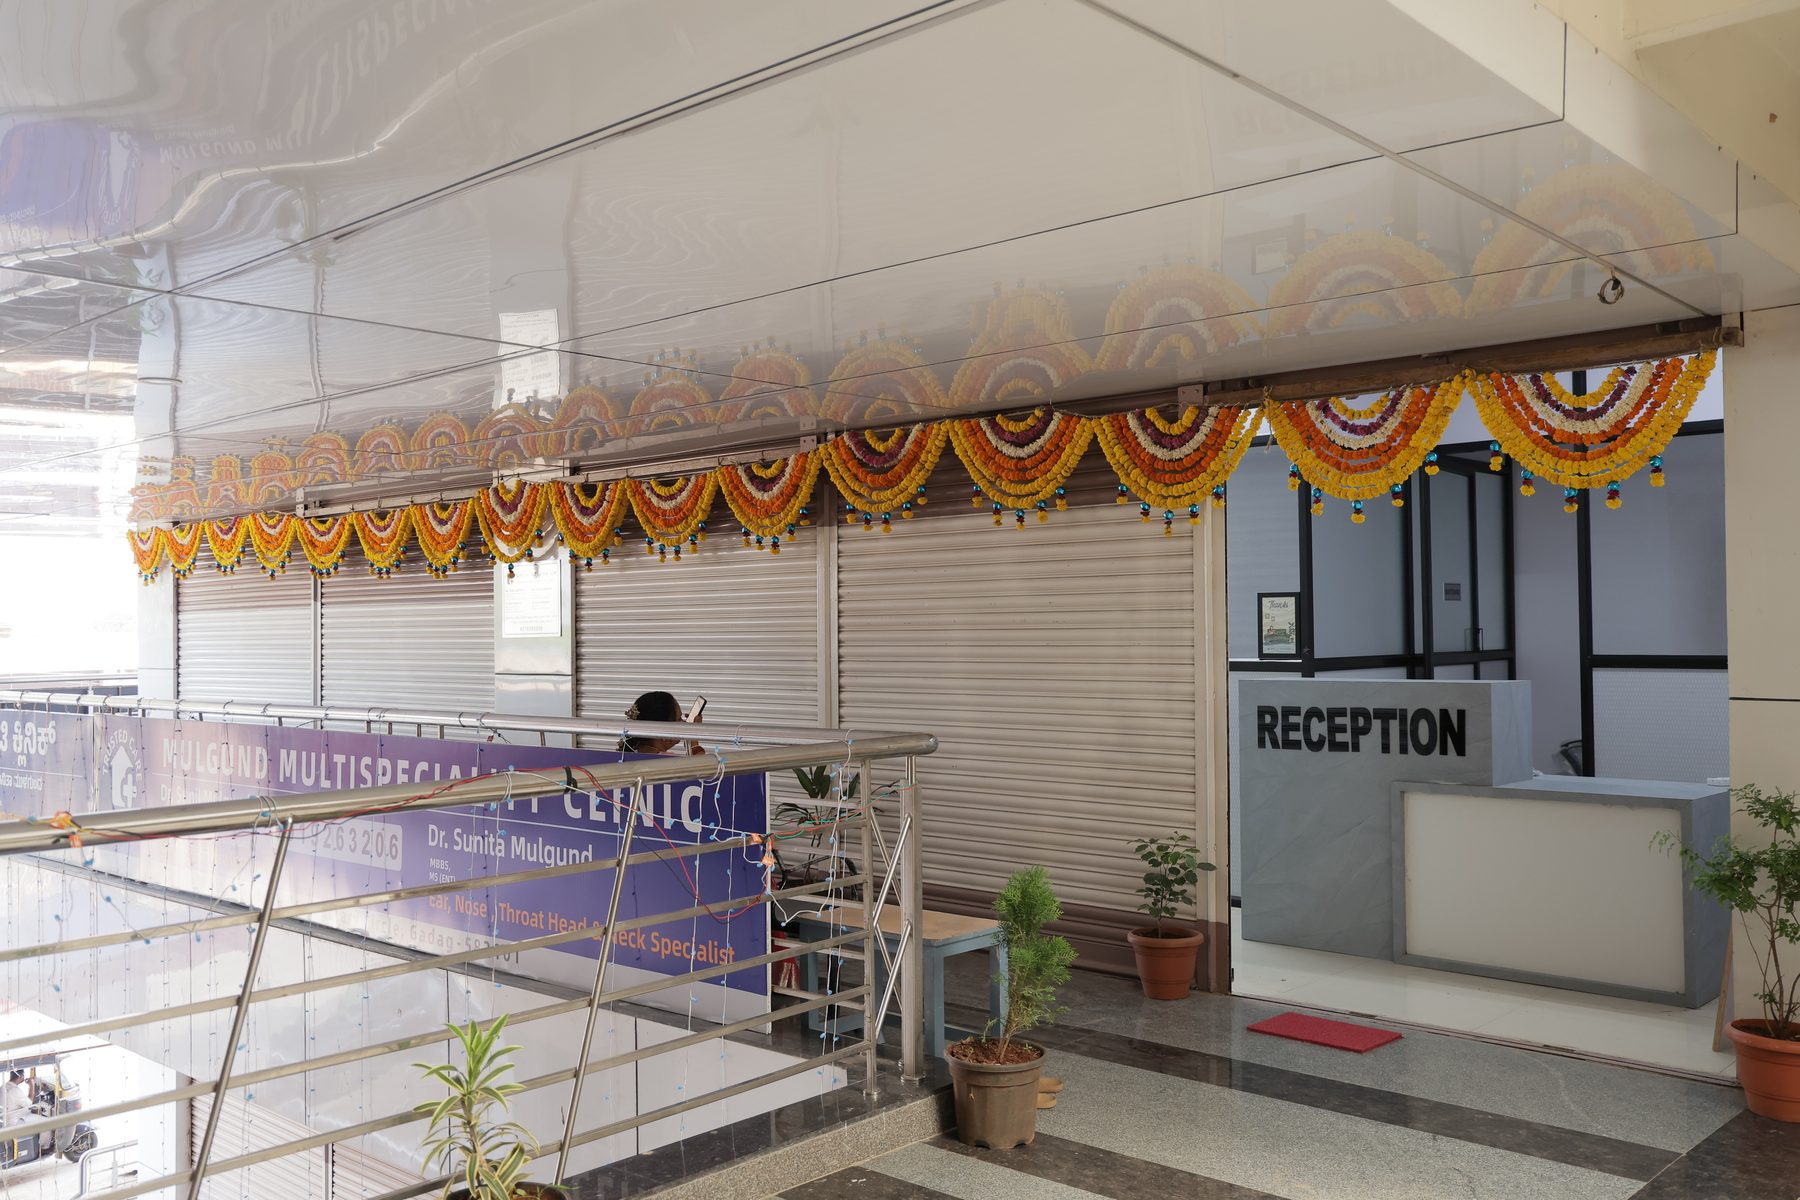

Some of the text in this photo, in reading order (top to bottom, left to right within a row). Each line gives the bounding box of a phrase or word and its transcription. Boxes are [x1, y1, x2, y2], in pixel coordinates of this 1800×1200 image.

[102, 728, 128, 776] TRUSTED
[1257, 705, 1466, 757] RECEPTION
[162, 738, 268, 780] MULGUND
[563, 783, 703, 833] CLINIC
[428, 824, 593, 868] Dr. Sunita Mulgund
[429, 858, 451, 872] MBBS,
[429, 871, 439, 882] MS
[455, 895, 488, 917] Nose
[499, 902, 544, 928] Throat
[548, 912, 587, 932] Head
[651, 932, 735, 965] Specalist
